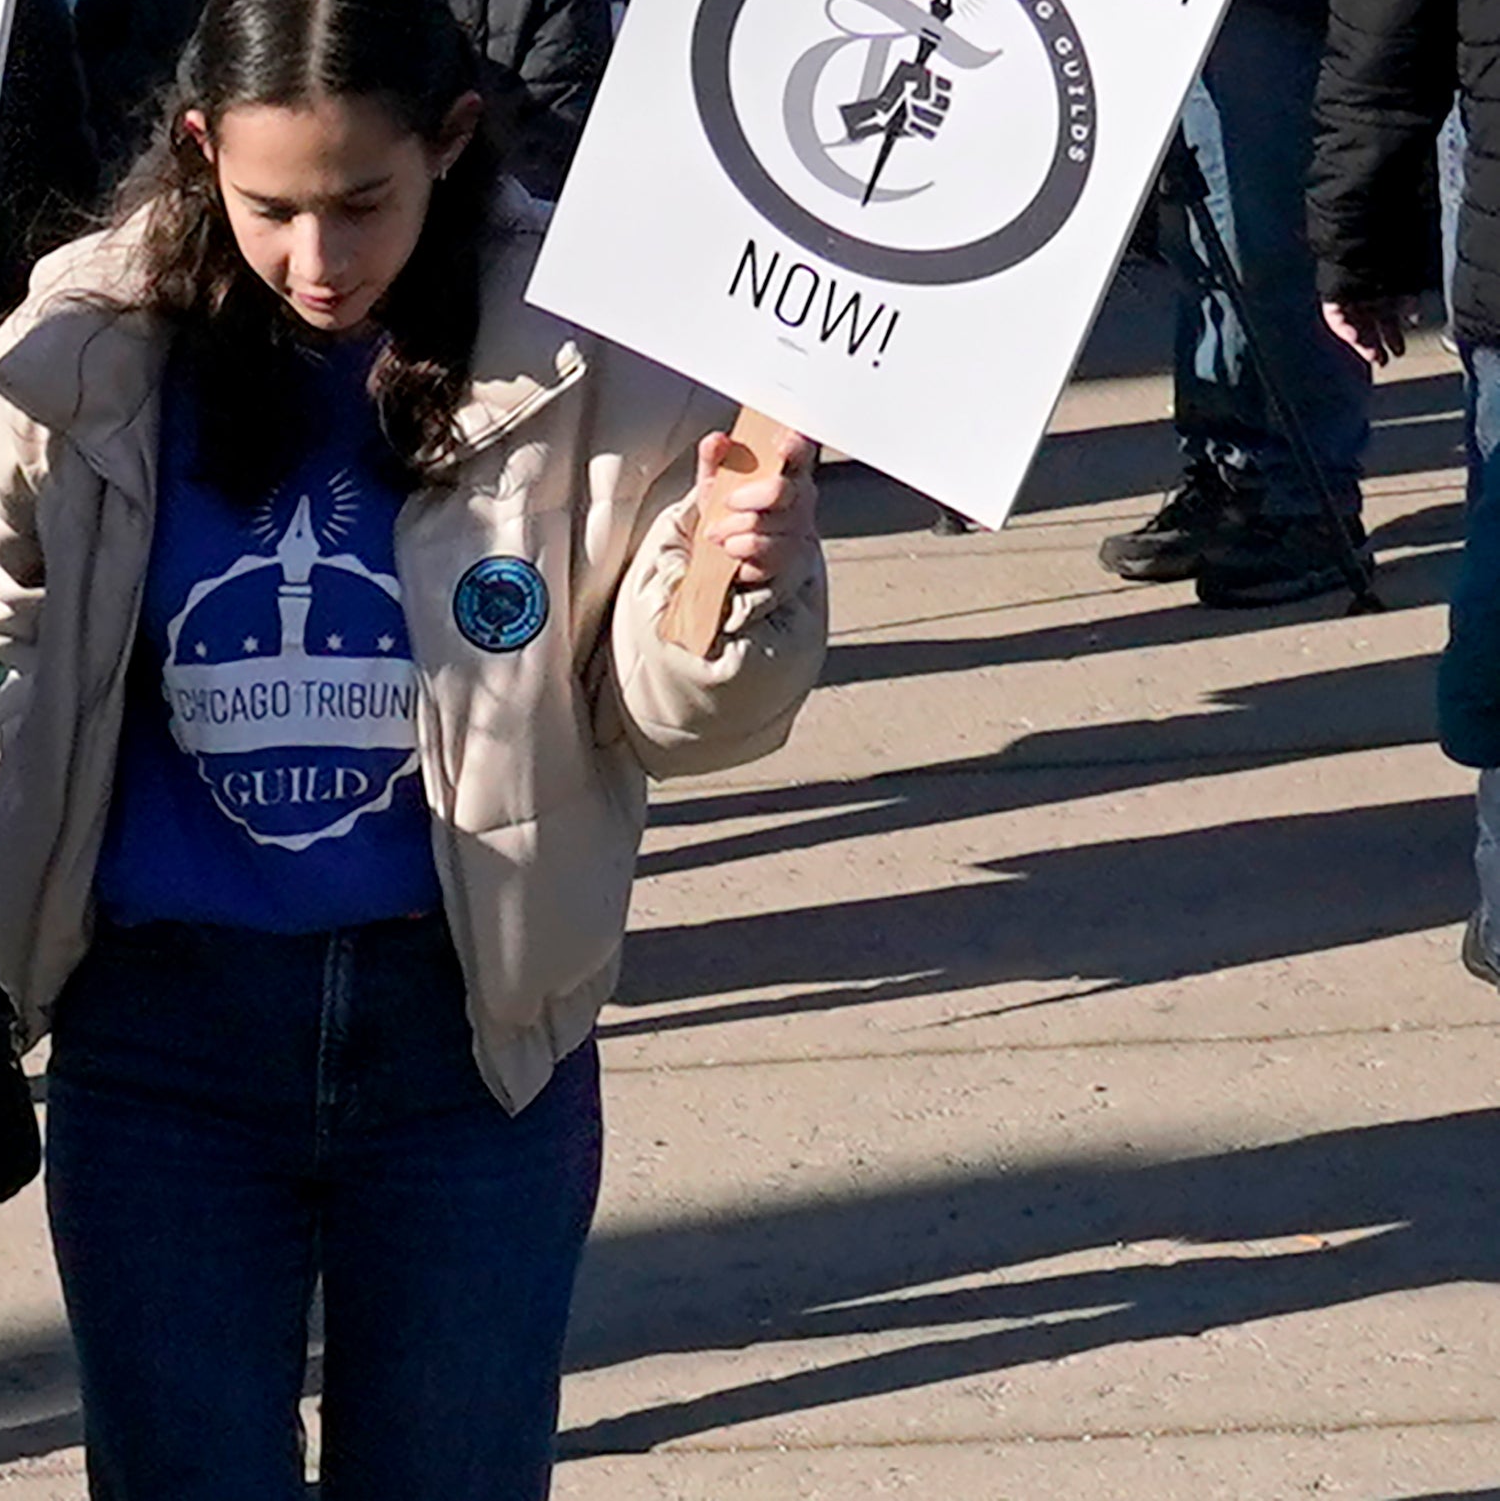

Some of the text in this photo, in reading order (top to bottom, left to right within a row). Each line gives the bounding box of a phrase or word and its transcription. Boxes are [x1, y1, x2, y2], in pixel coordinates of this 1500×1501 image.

[1054, 34, 1089, 163] GUILDS
[727, 238, 901, 369] NOW!
[177, 679, 419, 725] CHCAGO TRIBUN
[222, 766, 369, 807] GUILD
